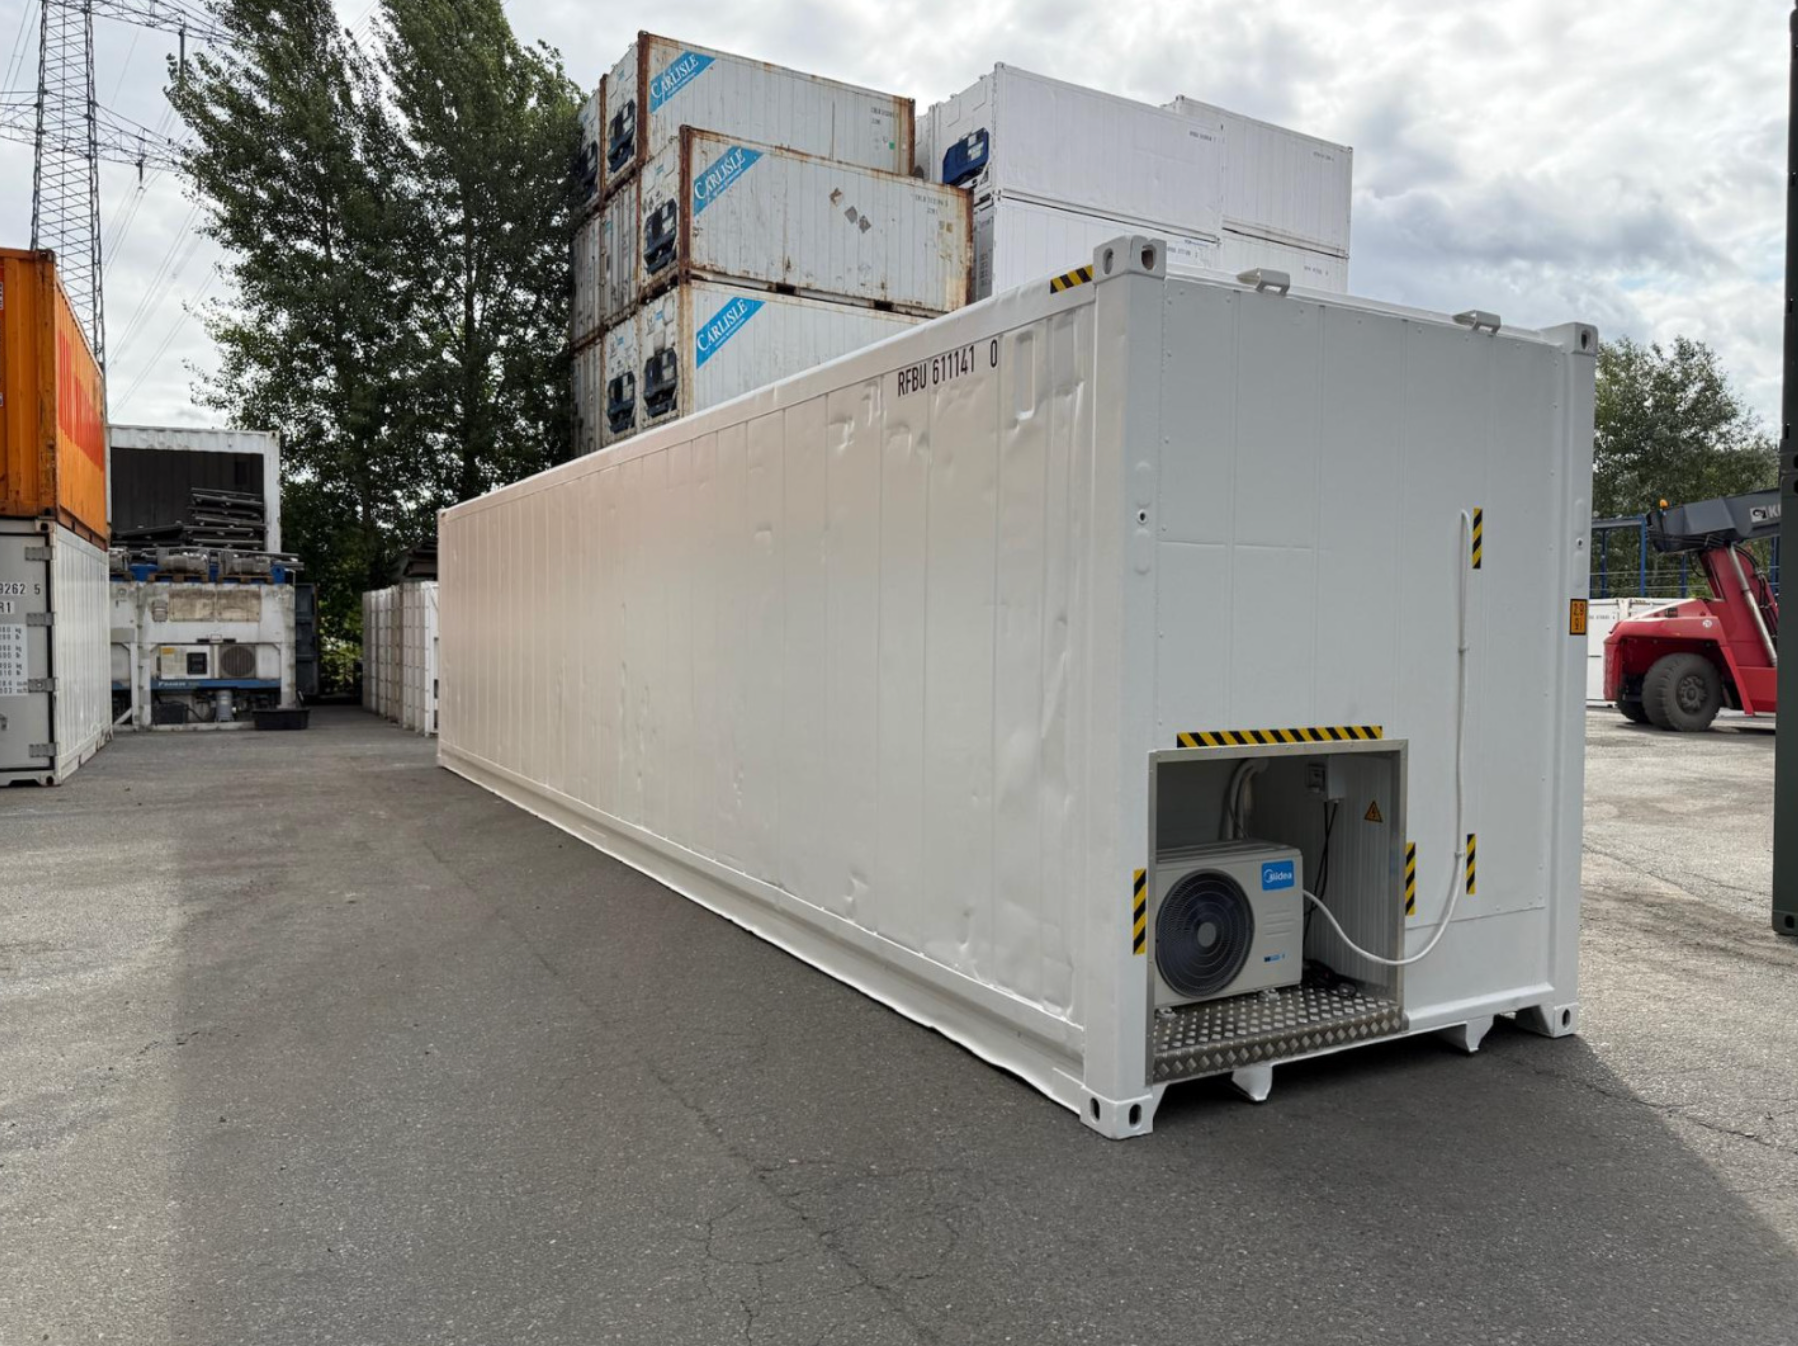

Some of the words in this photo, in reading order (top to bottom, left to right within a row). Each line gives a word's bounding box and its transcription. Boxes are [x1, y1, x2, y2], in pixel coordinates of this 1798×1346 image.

[651, 54, 699, 99] CARLISLE
[694, 148, 746, 199] CARLISLE
[697, 299, 748, 351] CARLISLE
[898, 362, 927, 397] RFBU
[932, 345, 975, 385] 611141
[990, 339, 998, 368] 0
[34, 583, 40, 595] 5
[1263, 868, 1292, 883] Midea
